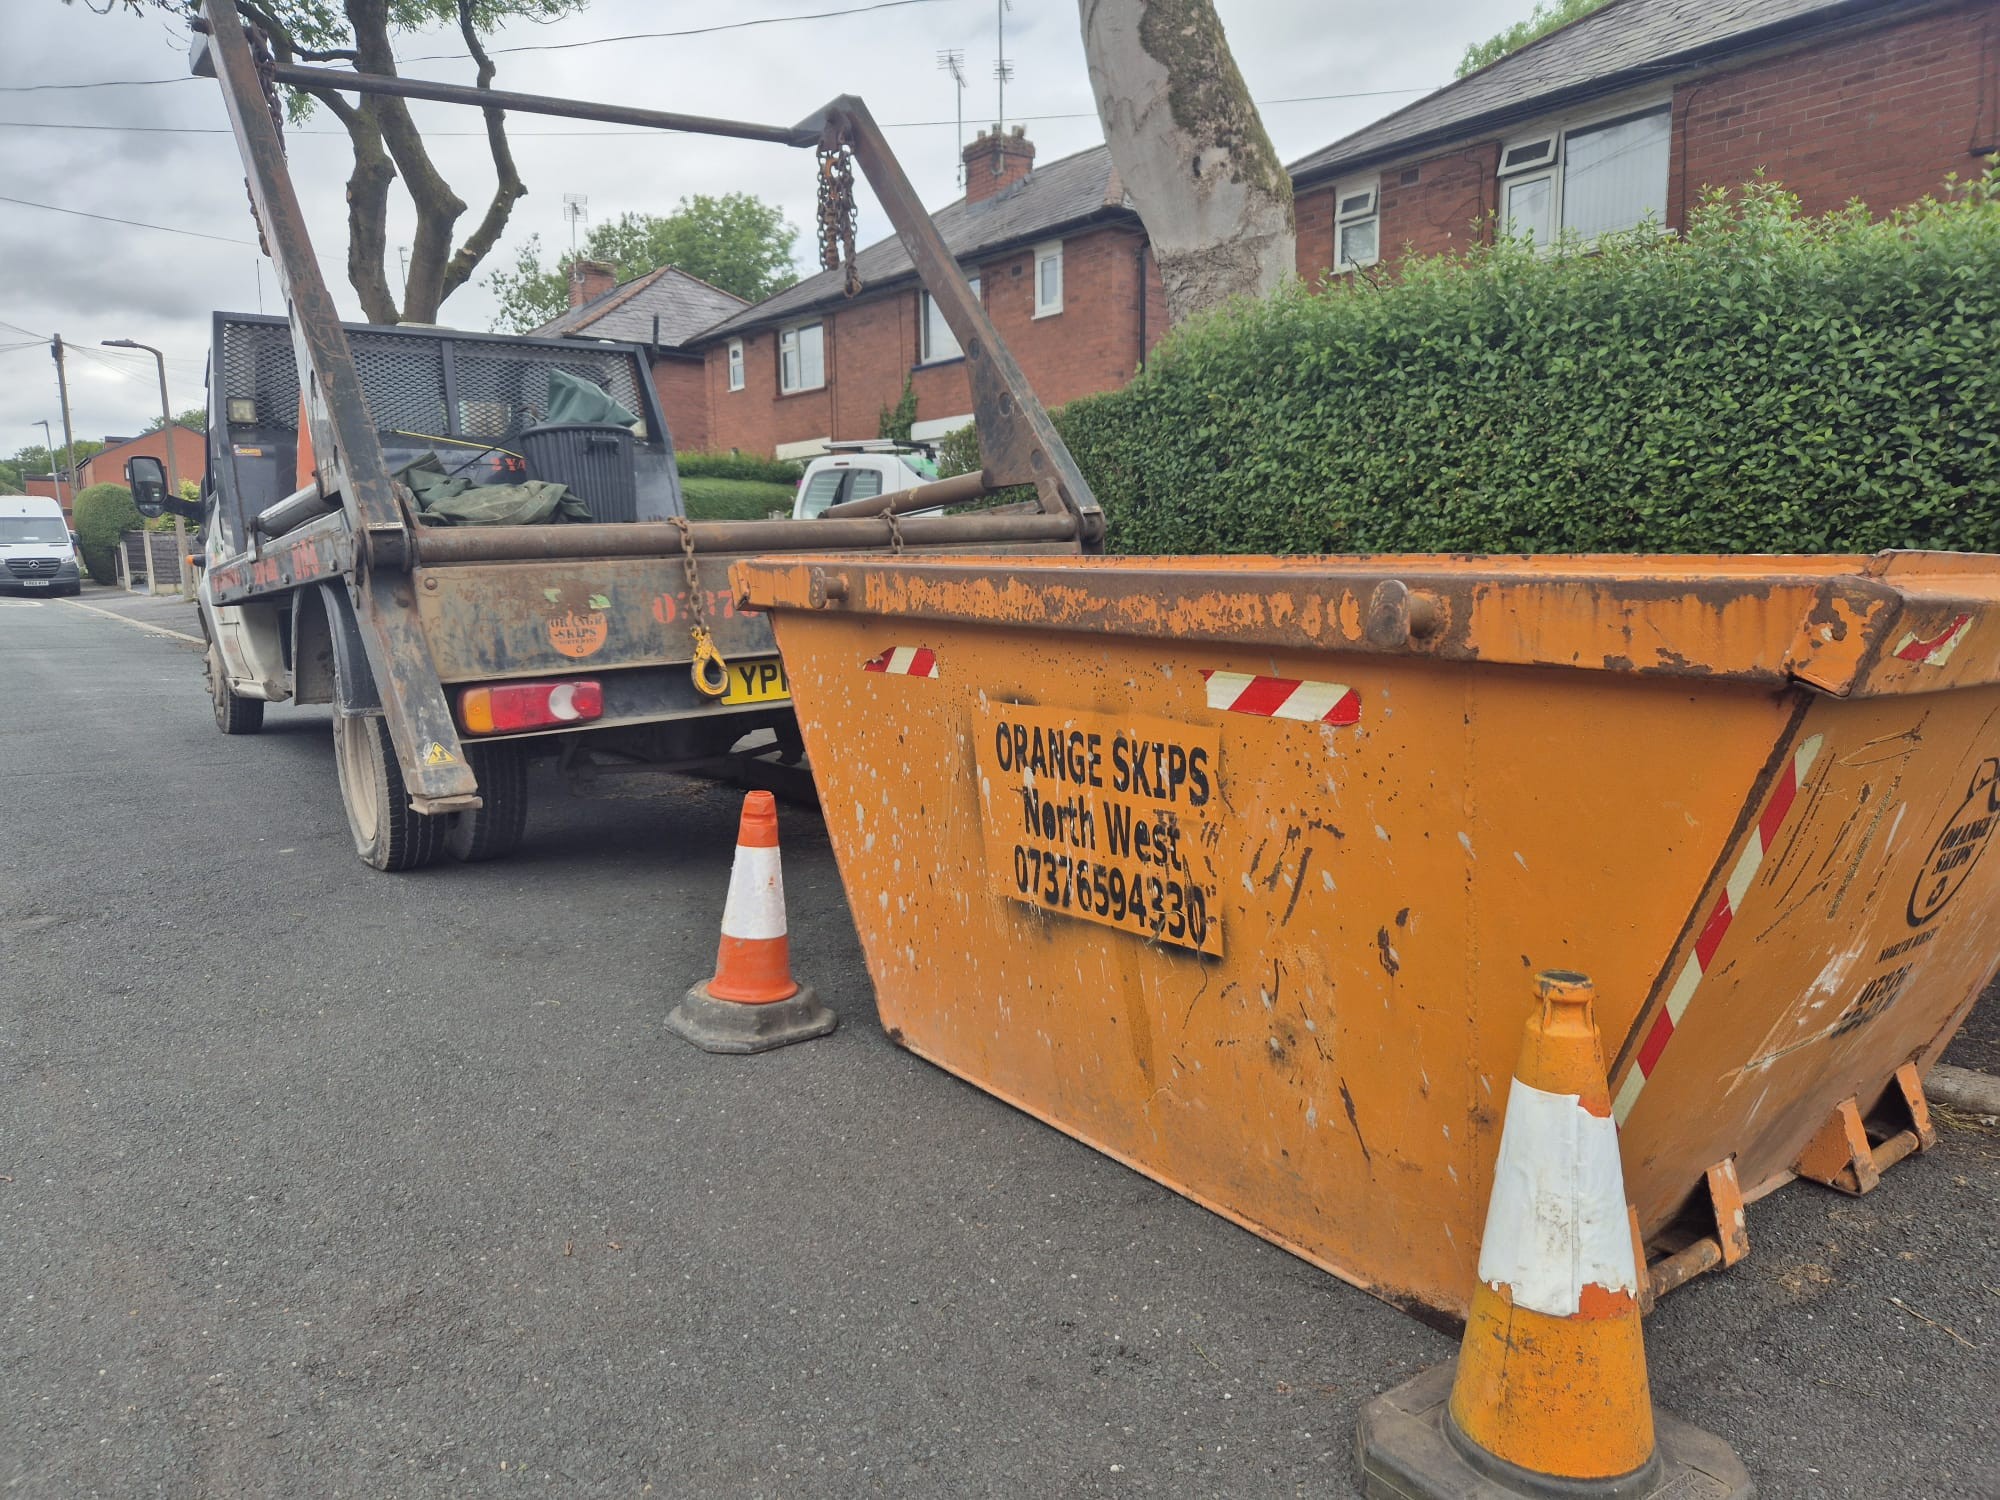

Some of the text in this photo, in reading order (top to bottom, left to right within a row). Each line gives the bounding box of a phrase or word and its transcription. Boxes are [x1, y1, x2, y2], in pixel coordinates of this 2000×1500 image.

[995, 721, 1210, 807] ORANGE SKIPS
[1022, 785, 1183, 871] North West
[1931, 842, 1976, 876] SKIPS
[1940, 815, 1993, 851] ORANGE
[1014, 844, 1207, 946] 07376594330
